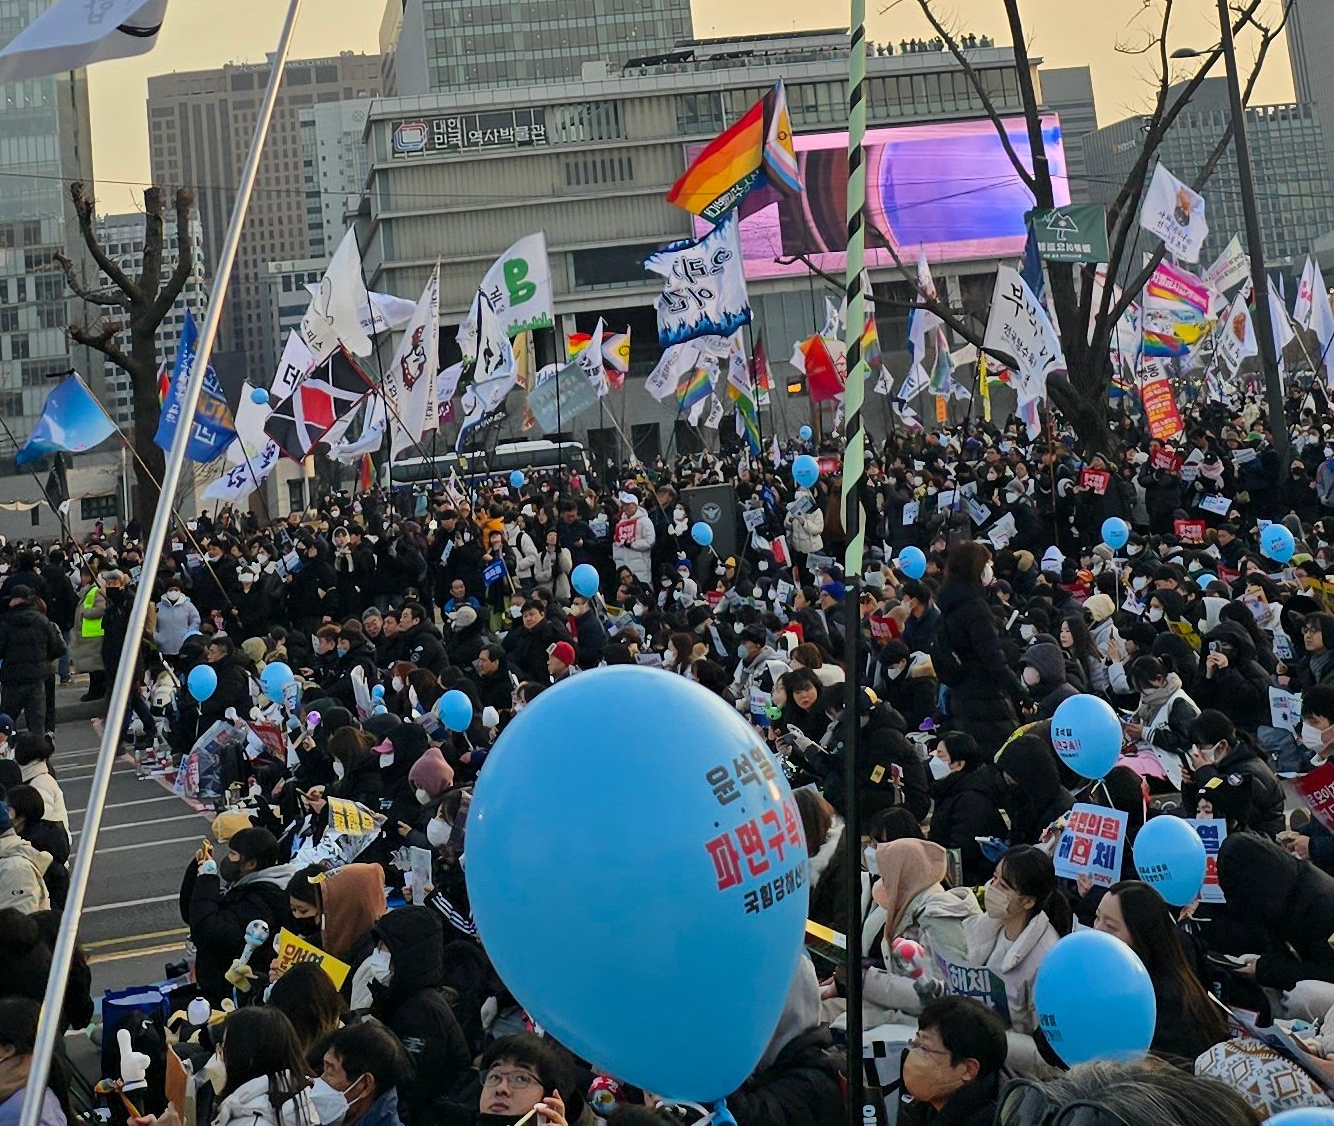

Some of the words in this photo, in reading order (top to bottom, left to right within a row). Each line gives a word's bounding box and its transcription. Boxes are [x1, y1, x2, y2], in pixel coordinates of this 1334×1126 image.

[433, 119, 461, 133] 대한
[468, 124, 546, 144] 역사박물관
[434, 133, 463, 149] 민국
